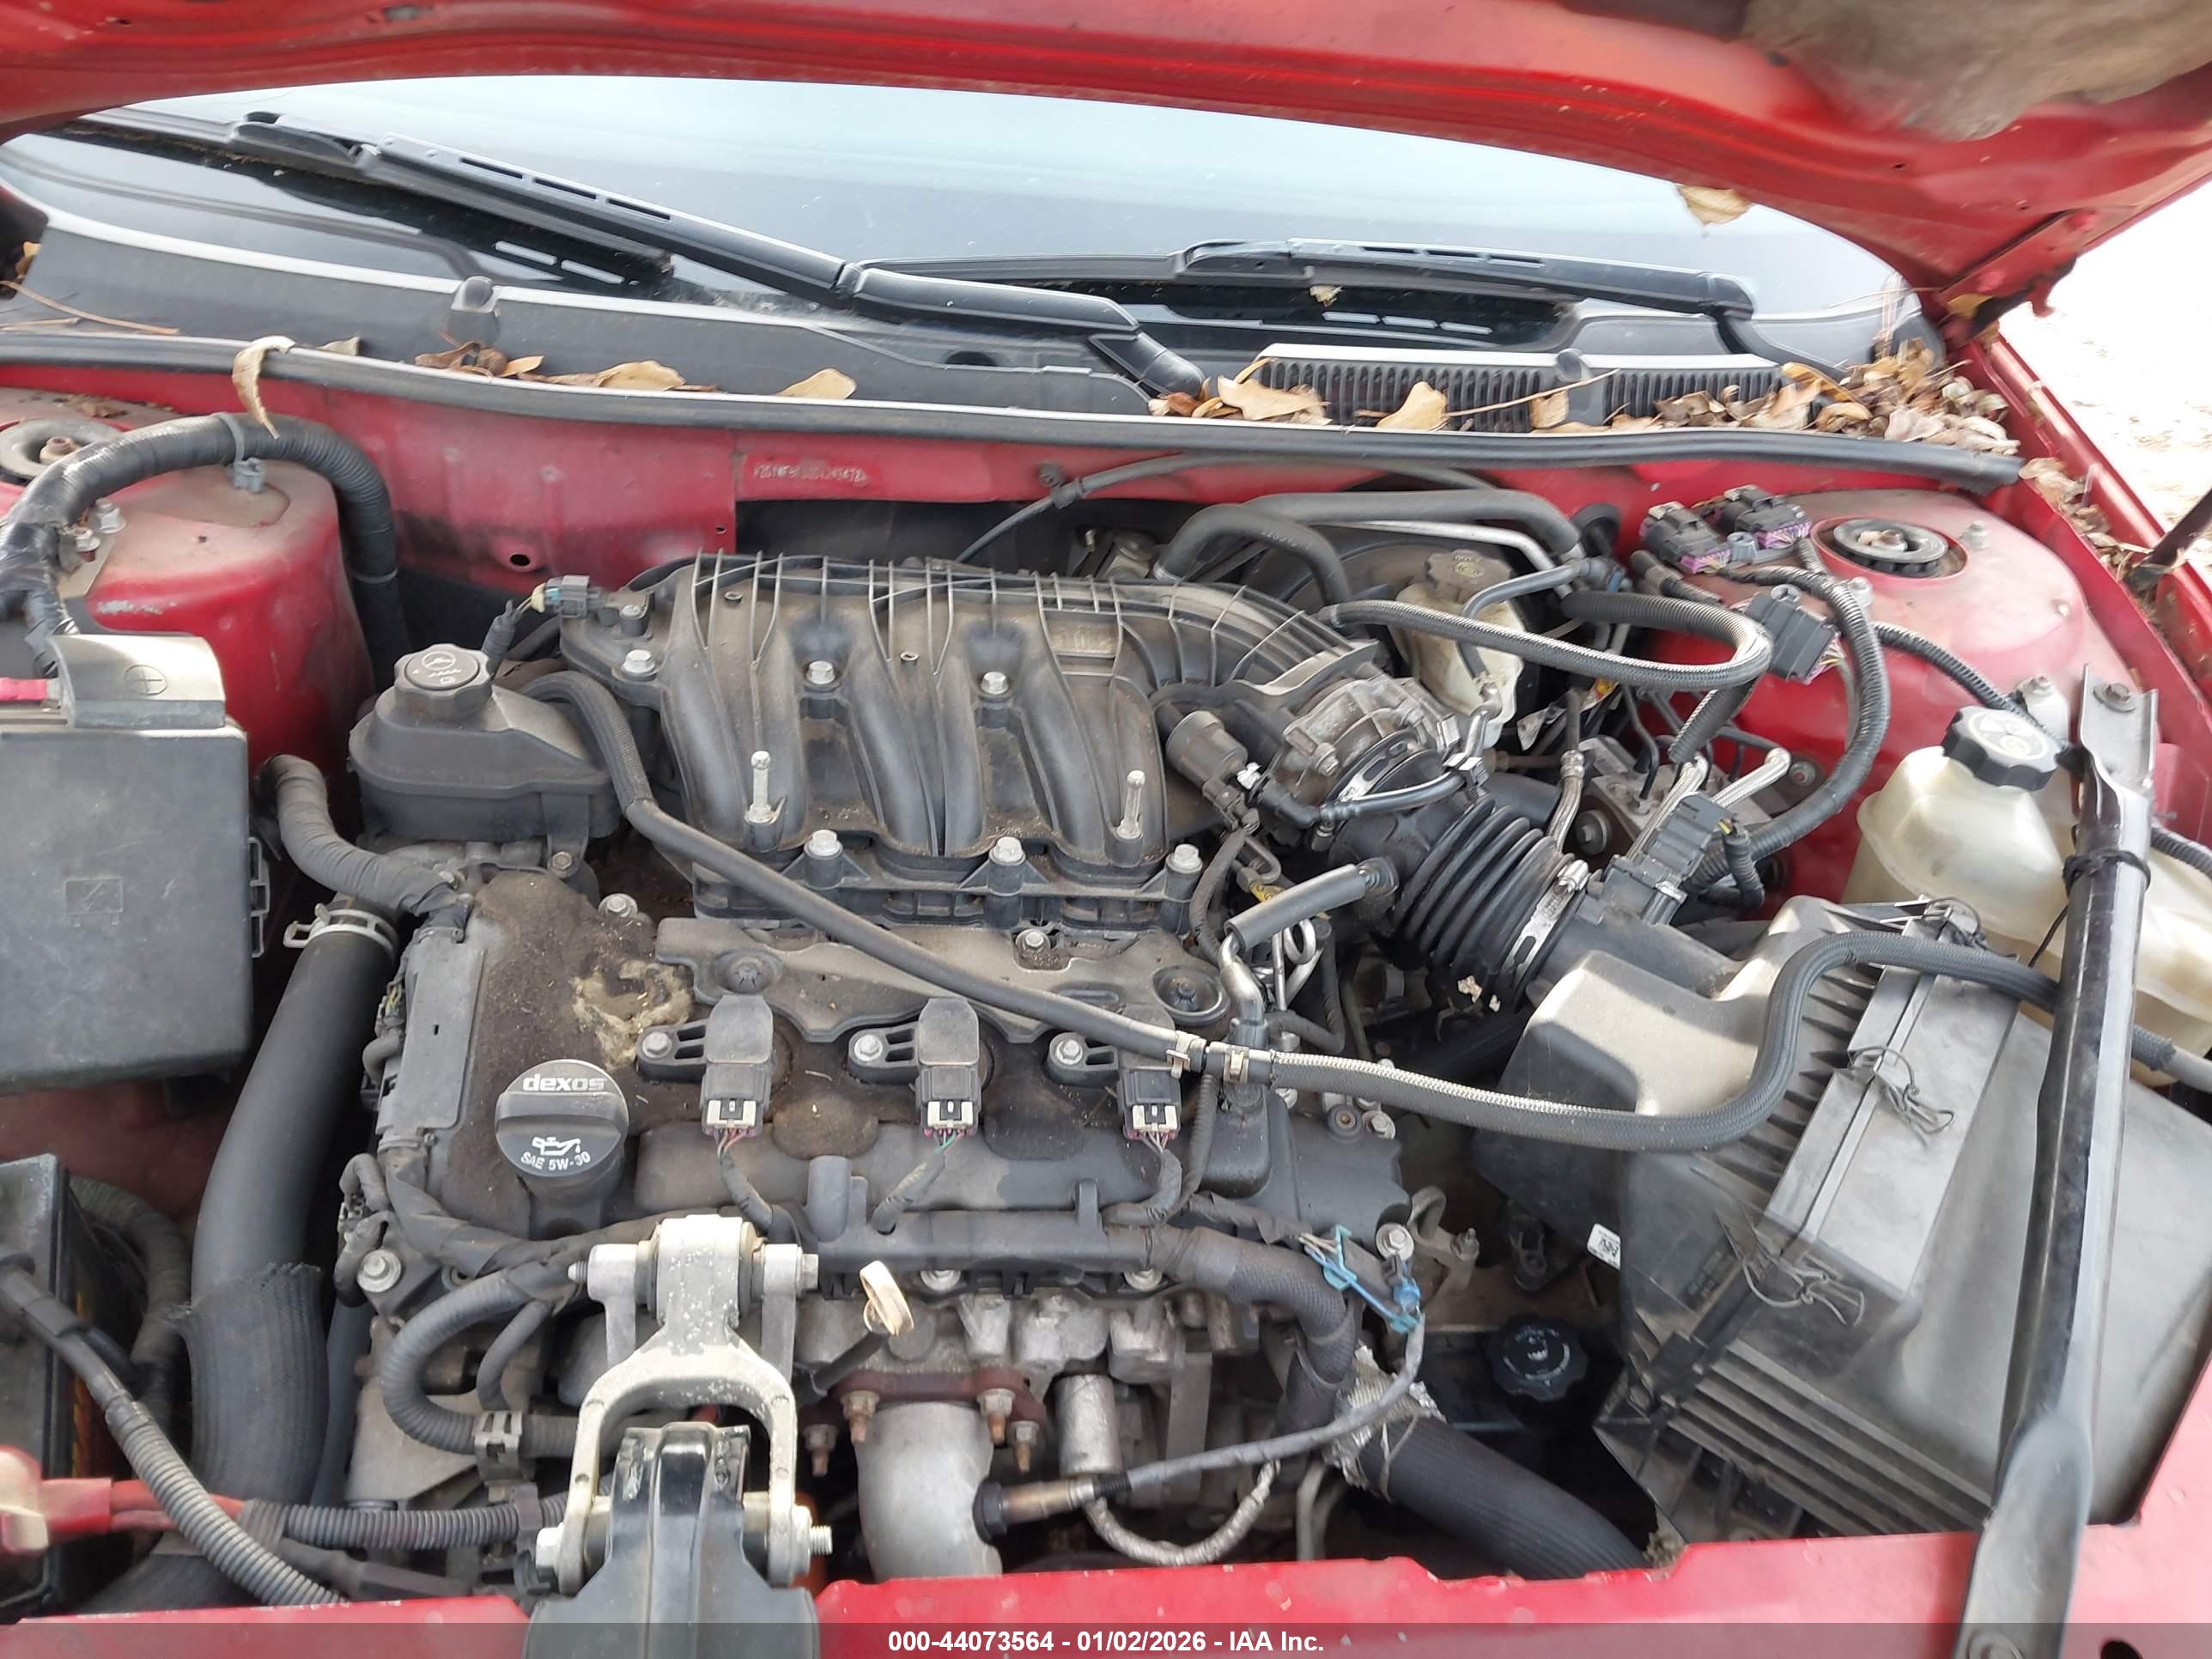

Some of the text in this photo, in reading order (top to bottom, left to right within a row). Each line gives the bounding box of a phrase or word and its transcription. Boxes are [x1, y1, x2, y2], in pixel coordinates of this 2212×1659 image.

[523, 1074, 605, 1091] dexos
[521, 1152, 591, 1170] SAE 5W-30
